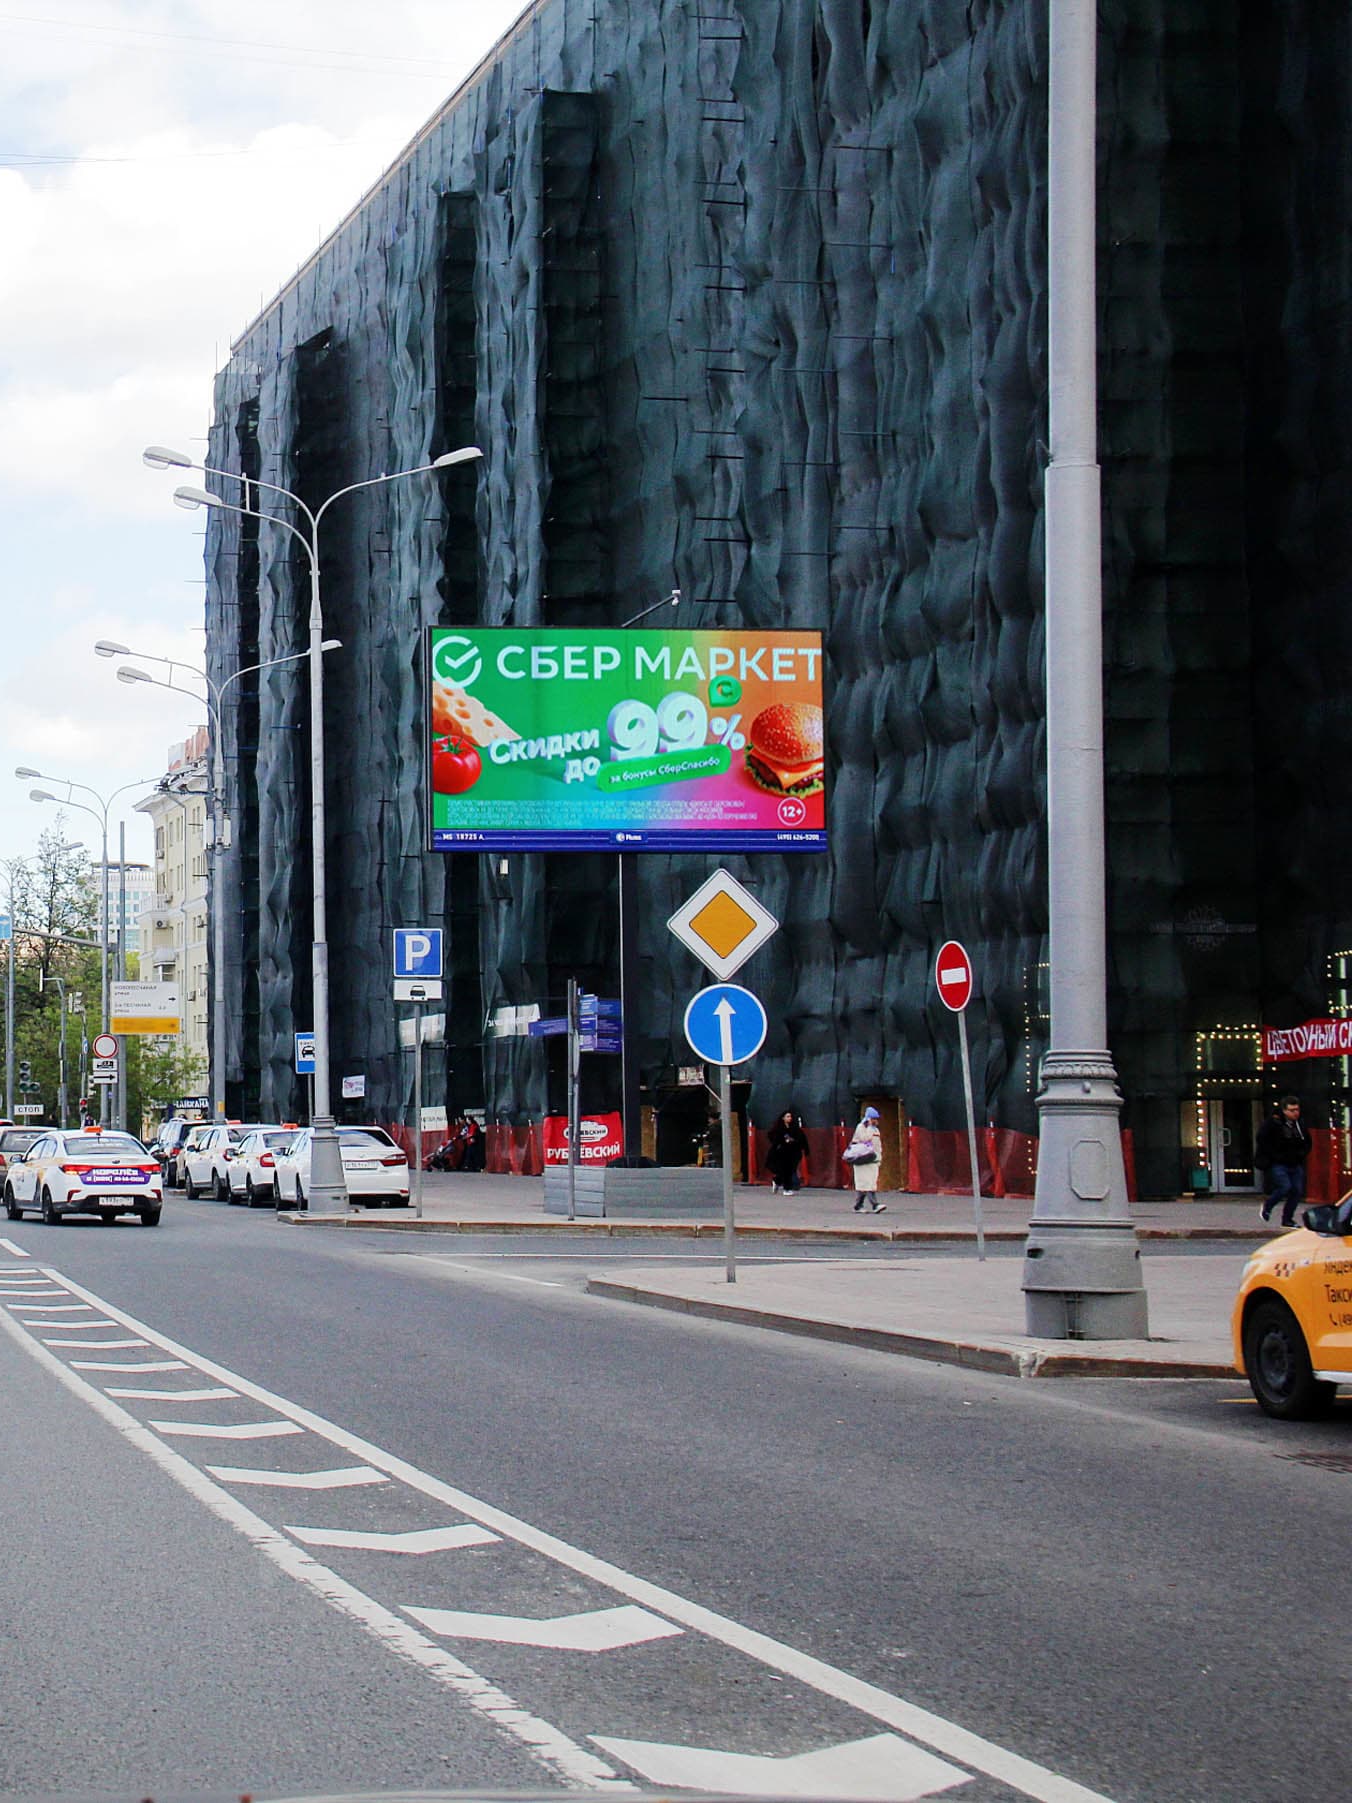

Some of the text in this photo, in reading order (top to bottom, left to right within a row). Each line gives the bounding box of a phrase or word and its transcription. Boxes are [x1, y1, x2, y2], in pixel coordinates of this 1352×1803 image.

[497, 646, 822, 681] СБЕР МАРКЕТ
[488, 728, 600, 765] Скидки
[563, 756, 602, 784] до
[622, 769, 658, 783] бонусы
[781, 805, 803, 818] 12+
[405, 934, 432, 971] P
[547, 1141, 621, 1159] РУБЁВСКИЙ
